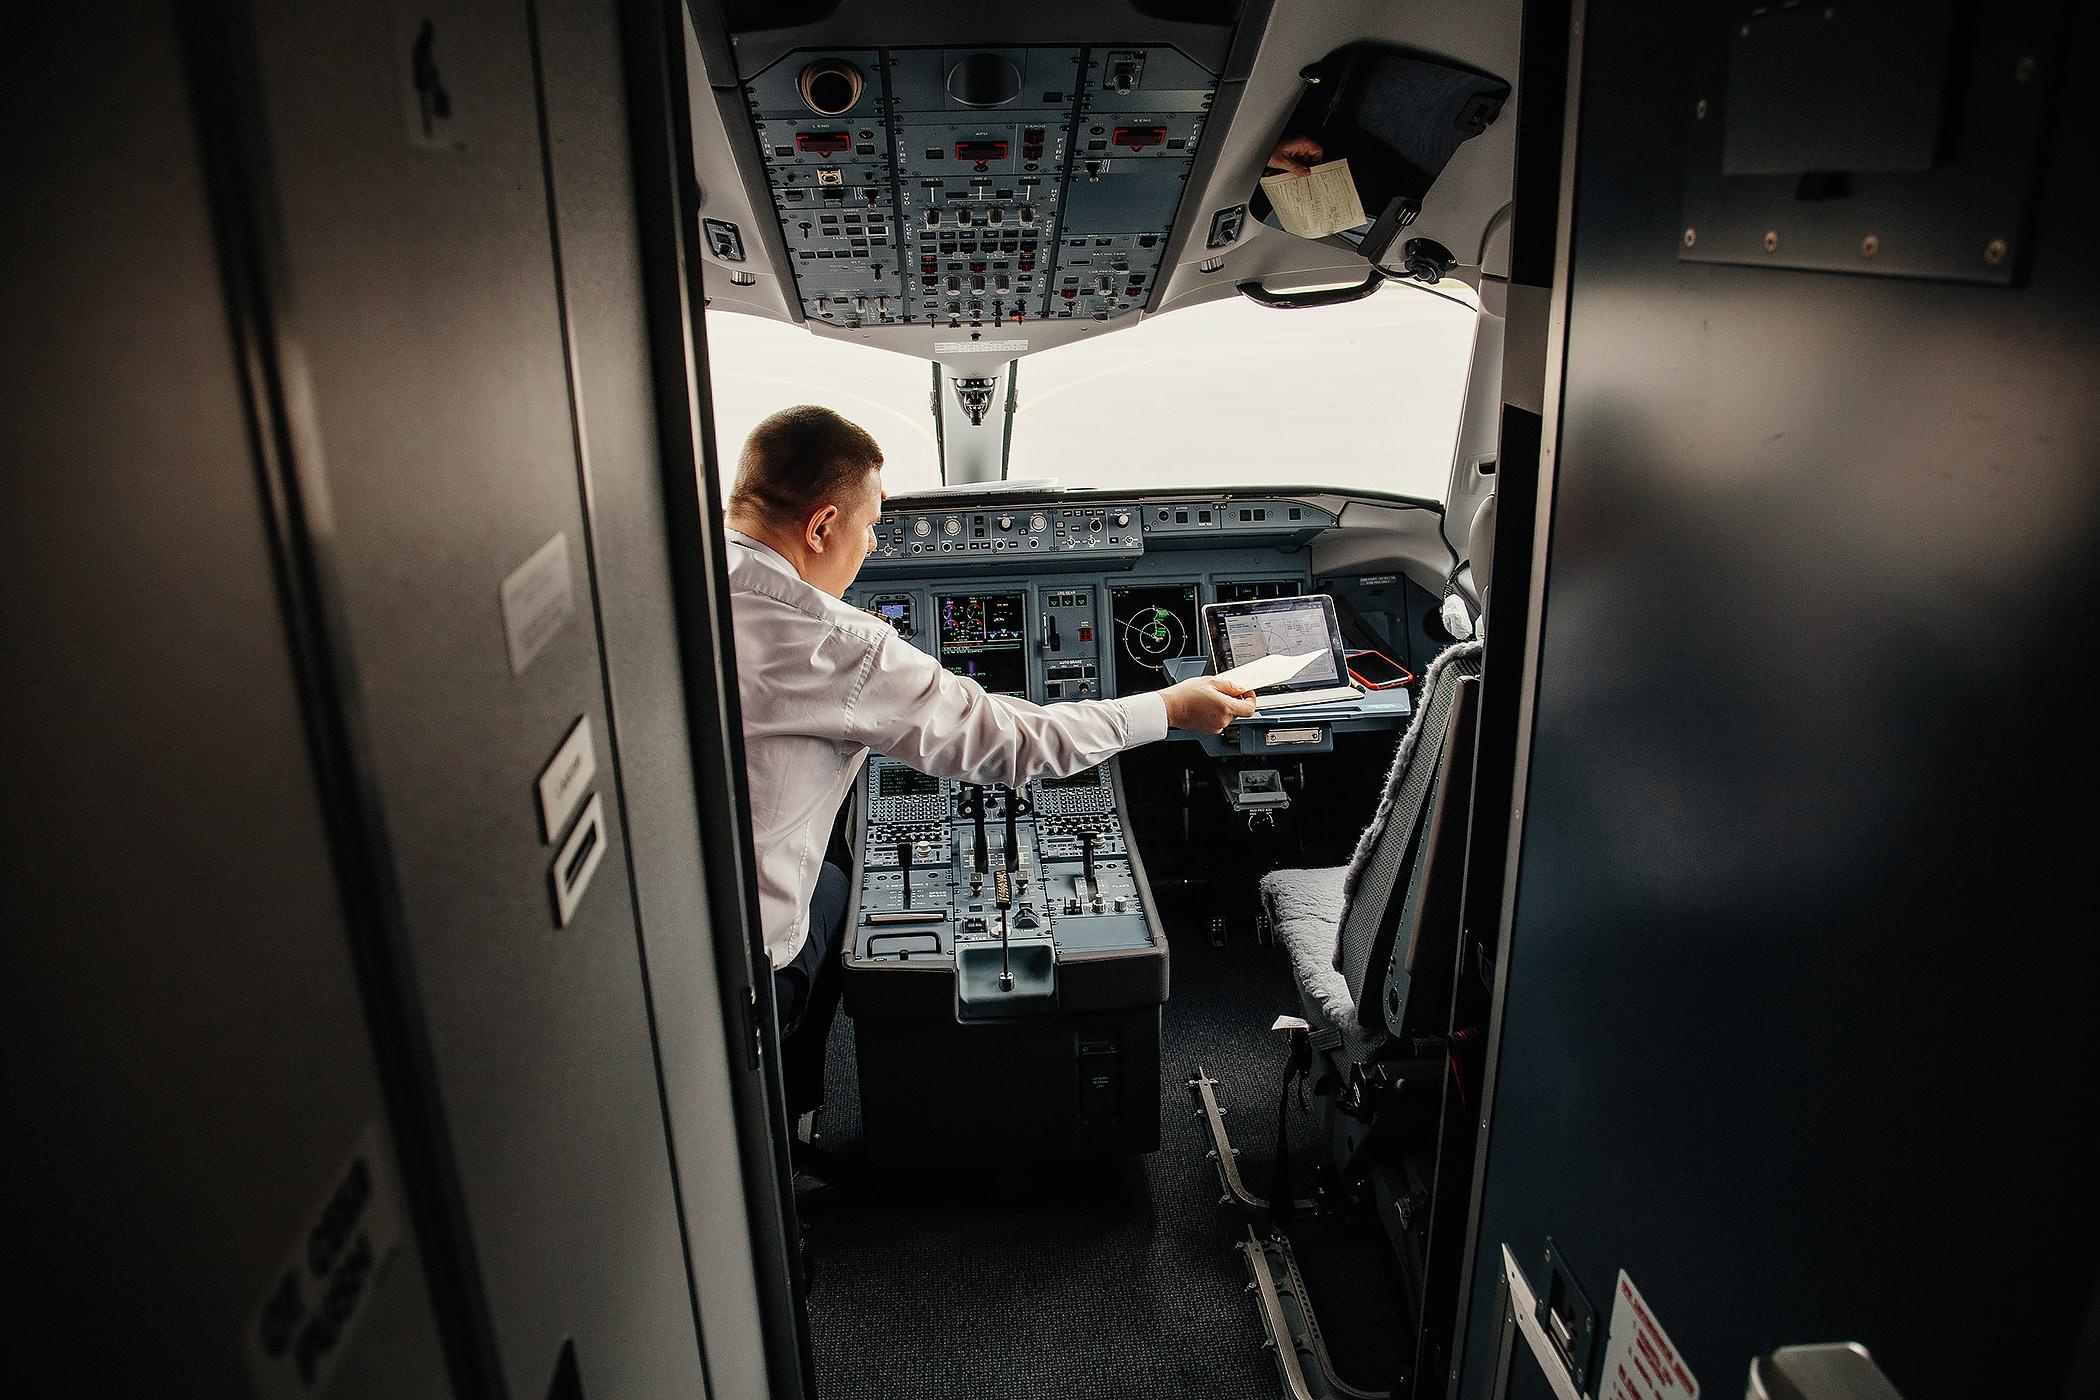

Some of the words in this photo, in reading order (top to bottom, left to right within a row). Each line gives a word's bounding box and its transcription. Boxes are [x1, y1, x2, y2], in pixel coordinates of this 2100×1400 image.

[760, 131, 772, 155] FIRE
[1188, 124, 1200, 147] FIRE
[898, 140, 907, 164] FIRE
[1055, 137, 1063, 161] FIRE
